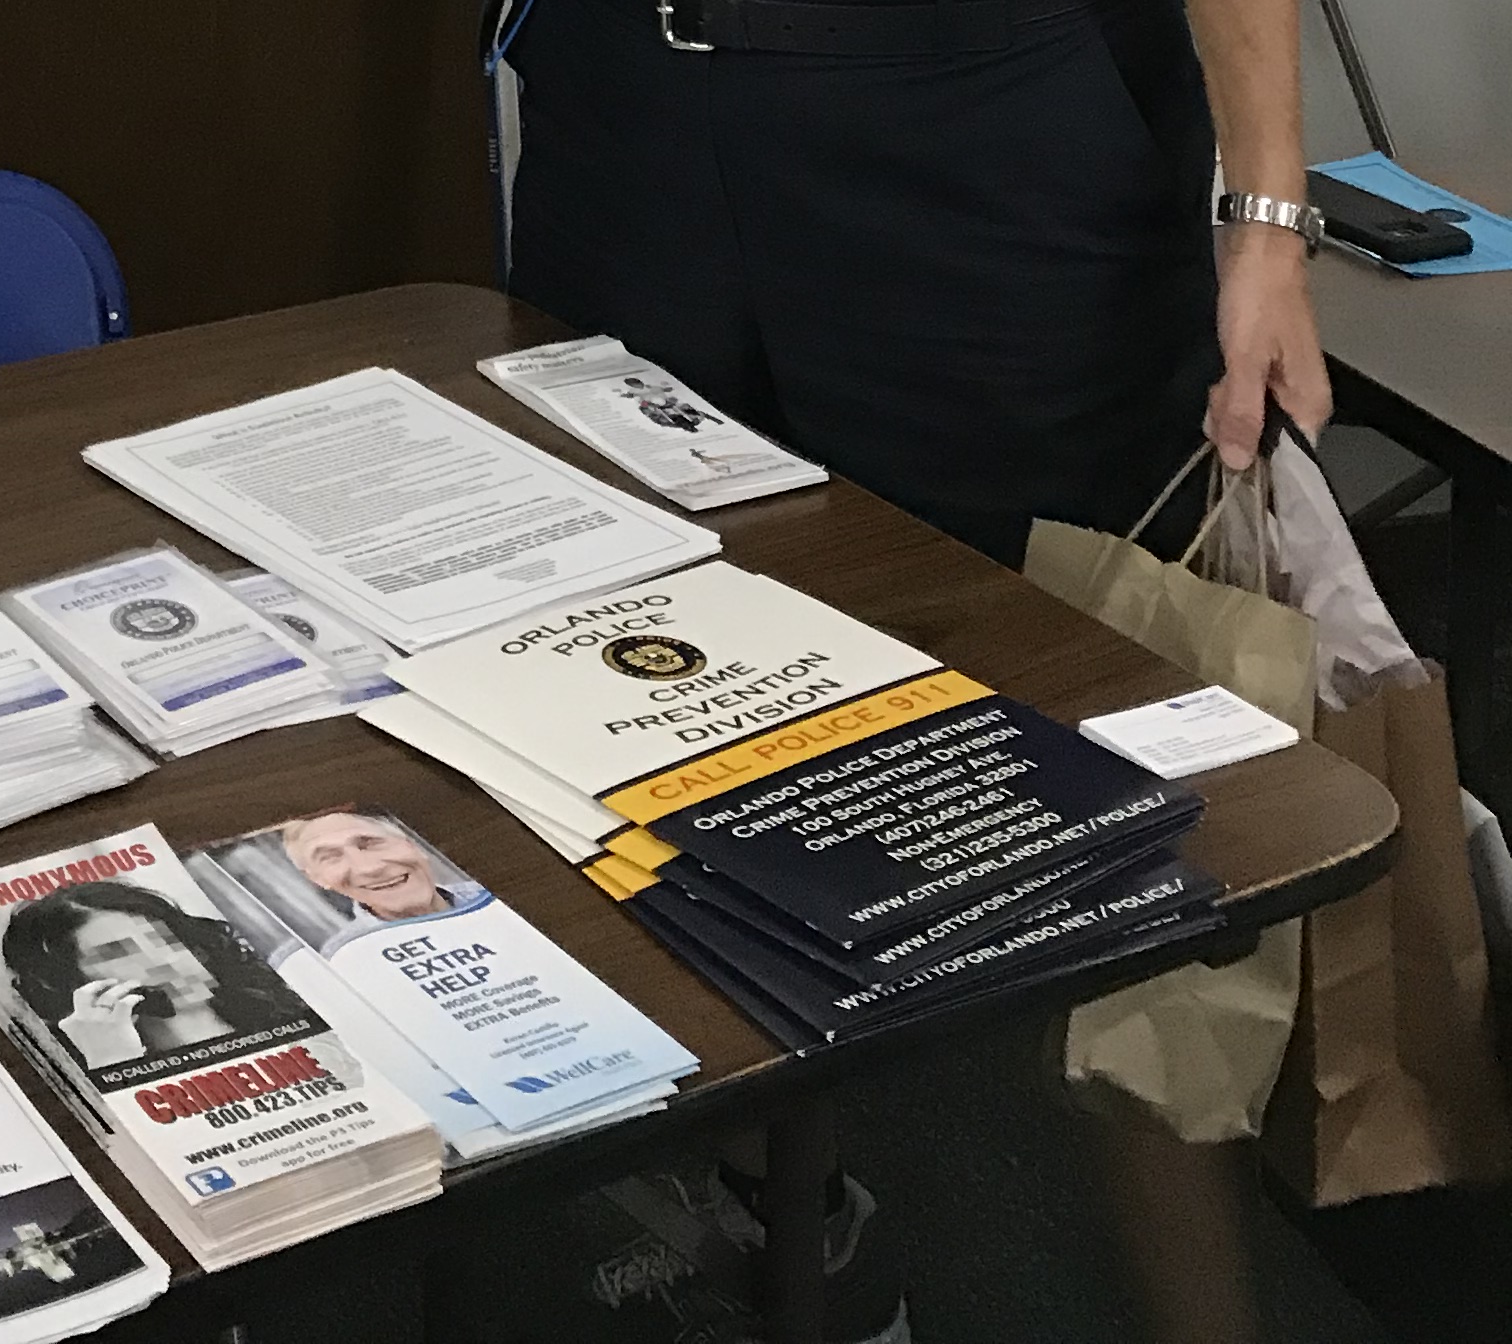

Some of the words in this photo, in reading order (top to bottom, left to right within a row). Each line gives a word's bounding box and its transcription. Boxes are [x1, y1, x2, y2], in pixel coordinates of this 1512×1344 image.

[499, 593, 674, 657] ORLANDO
[551, 612, 677, 658] POLICE
[603, 650, 833, 737] PREVENTION
[647, 660, 759, 704] CRIME
[674, 675, 845, 744] DIVISION
[648, 760, 753, 803] CALL
[751, 705, 889, 762] POLICE
[889, 681, 951, 712] 911
[693, 785, 801, 831] ORLANDO
[796, 754, 879, 791] POLICE
[872, 708, 1009, 762] DEPARTMENT
[731, 806, 800, 840] CRIME
[800, 754, 932, 812] PREVENTION
[930, 726, 1024, 763] DIVISION
[792, 815, 833, 837] 100
[830, 791, 897, 822] SOUTH
[892, 763, 968, 796] HUGHEY
[898, 780, 980, 815] FLORIDA
[975, 758, 1040, 788] 32801
[382, 936, 438, 963] GET
[400, 942, 498, 982] EXTRA
[420, 965, 491, 999] HELP
[440, 993, 480, 1011] MORE
[481, 975, 539, 998] Coverage
[452, 1003, 490, 1021] MORE
[493, 988, 542, 1008] Savings
[464, 1012, 510, 1032] EXTRA
[509, 996, 561, 1017] Benefits
[101, 1072, 122, 1084] NO
[123, 1059, 170, 1079] CALLER
[191, 1048, 210, 1061] NO
[211, 1031, 272, 1055] RECORDED
[273, 1019, 311, 1037] CALLS
[544, 1049, 635, 1085] WellCare
[134, 1045, 333, 1125] CRIMELINE
[204, 1075, 347, 1130] 800.423.TIPS
[184, 1099, 369, 1166] www.crimeline.org
[238, 1134, 304, 1168] Download
[305, 1132, 326, 1145] the
[349, 1118, 376, 1133] Tips
[281, 1154, 305, 1168] app
[306, 1148, 326, 1161] for
[328, 1138, 356, 1154] free
